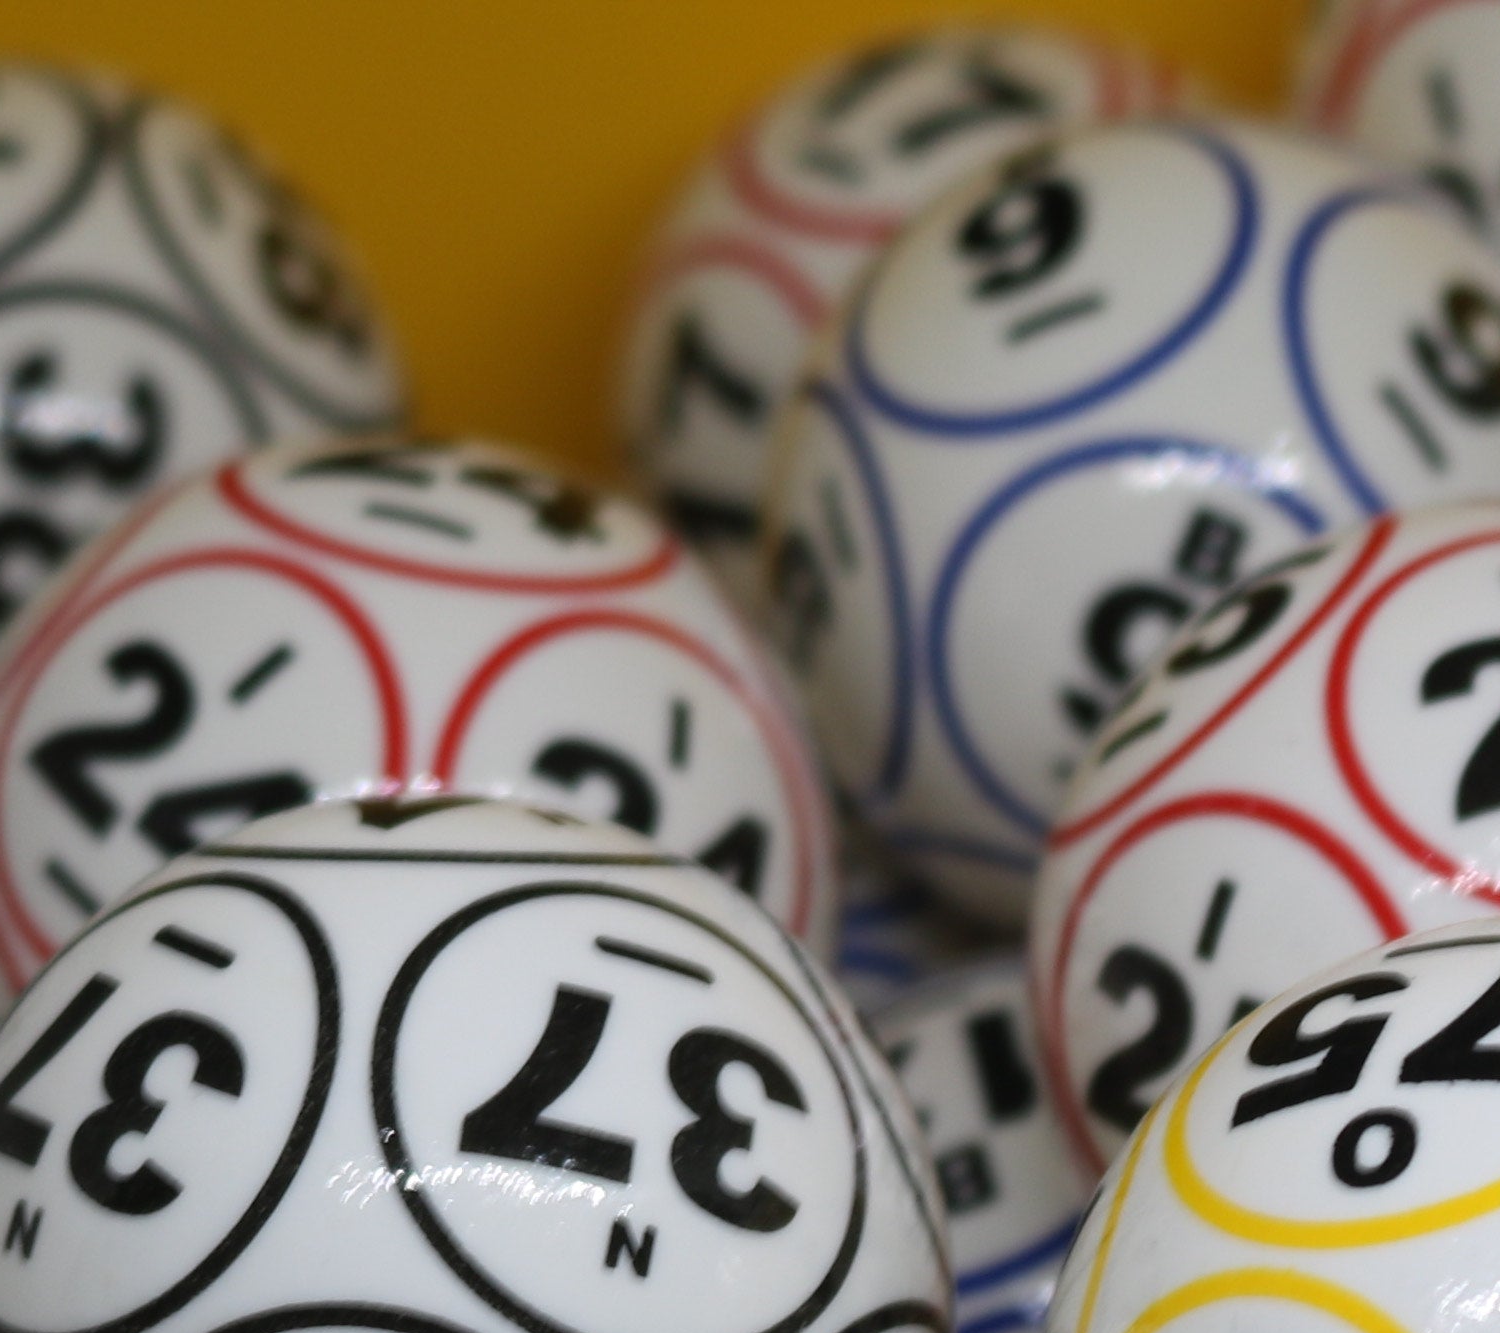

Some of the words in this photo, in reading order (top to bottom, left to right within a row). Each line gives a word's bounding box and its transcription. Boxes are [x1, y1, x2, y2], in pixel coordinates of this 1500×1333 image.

[954, 174, 1088, 304] 9
[456, 982, 810, 1236] 37
[1331, 1106, 1419, 1190] O
[3, 1206, 46, 1265] N
[603, 1216, 658, 1278] N
